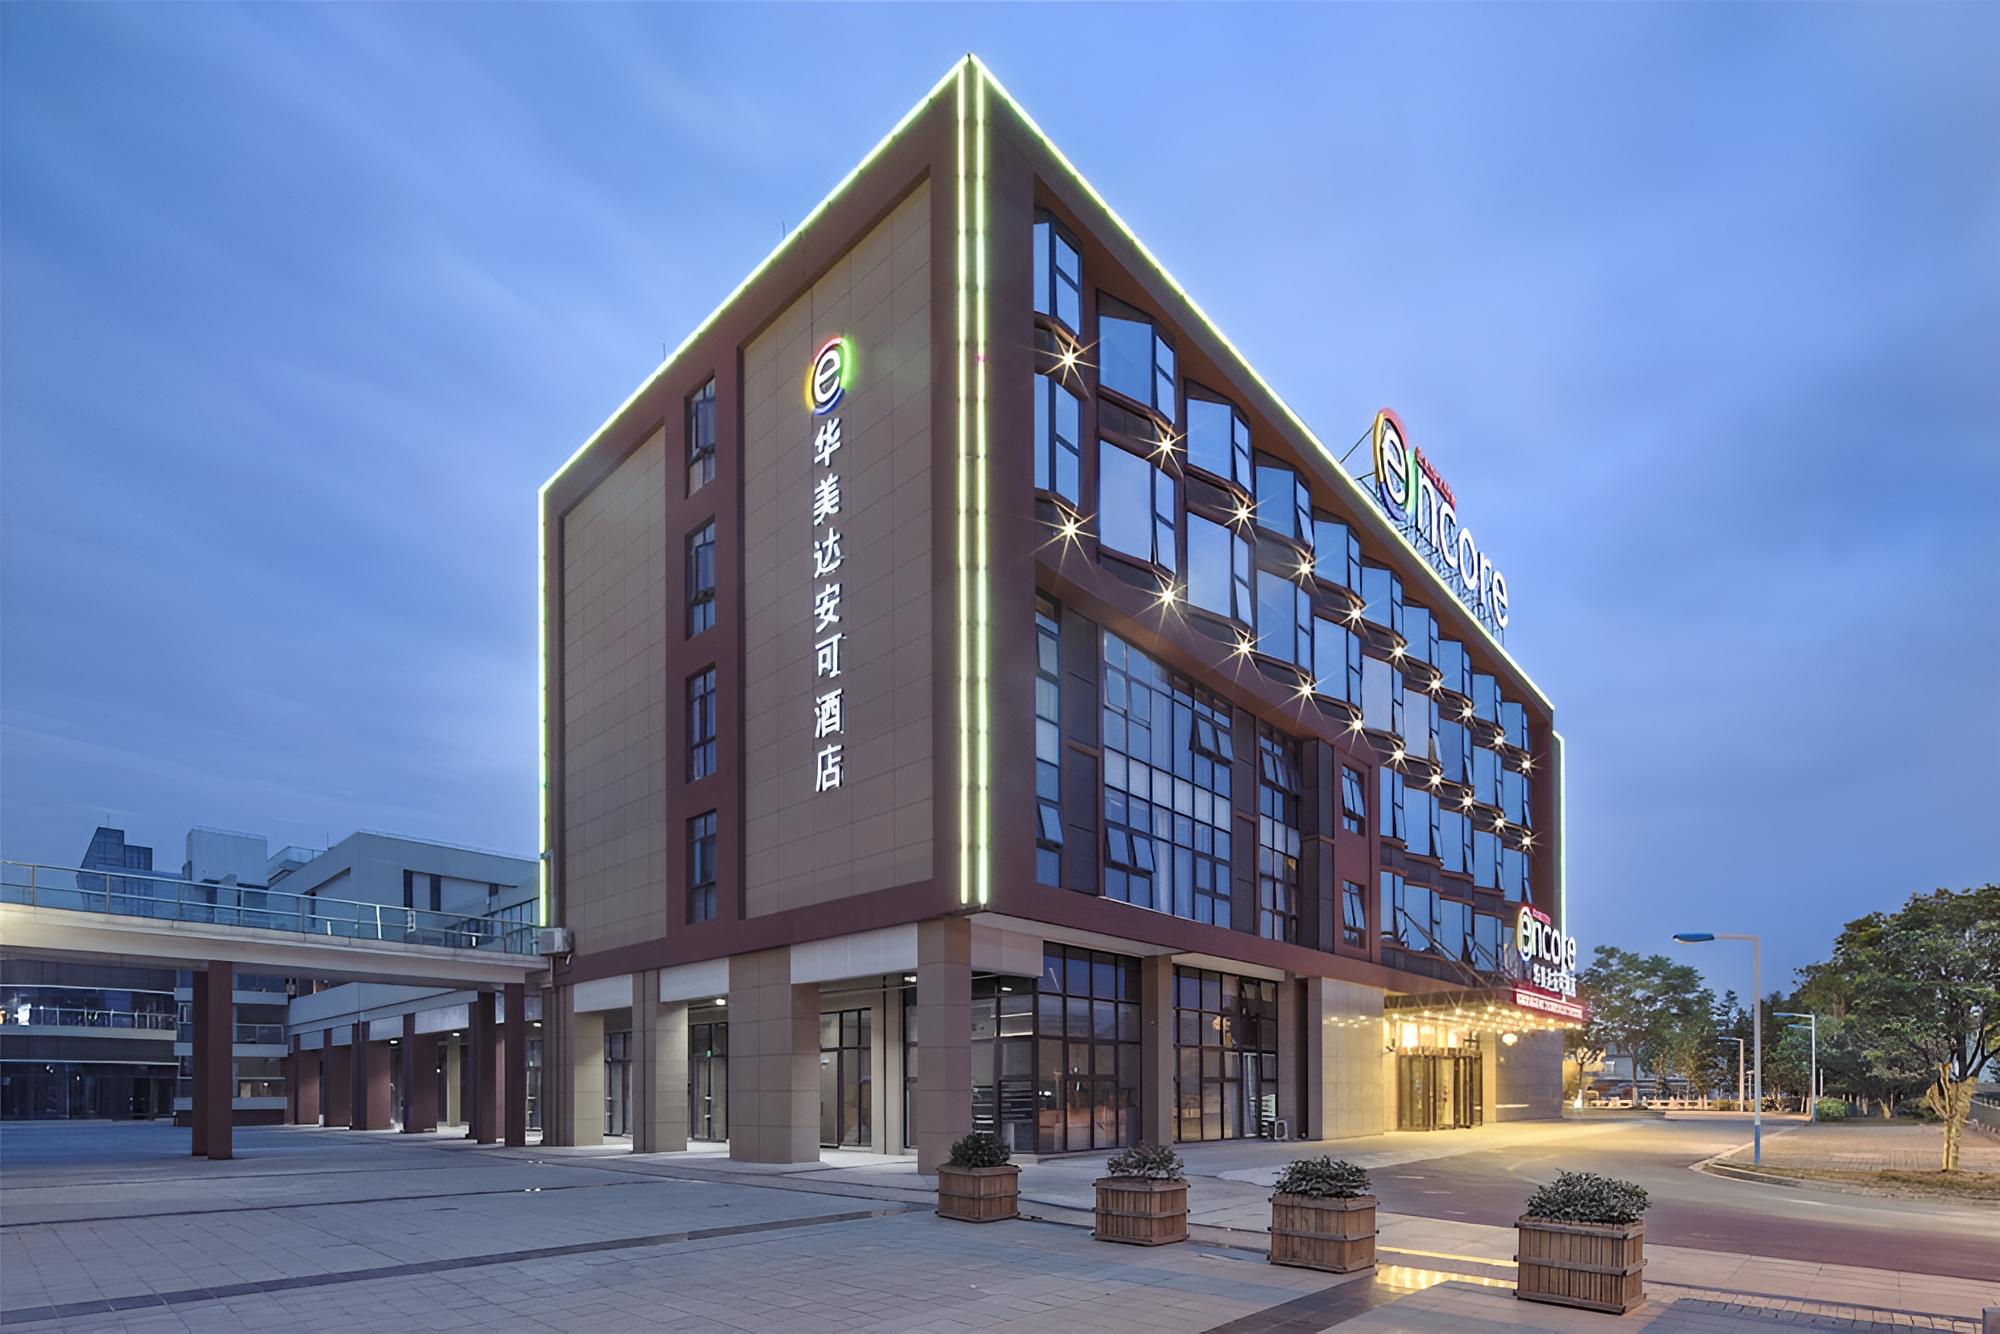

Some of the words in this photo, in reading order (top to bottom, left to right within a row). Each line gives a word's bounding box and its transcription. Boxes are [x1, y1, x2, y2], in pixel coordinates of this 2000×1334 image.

[813, 417, 843, 792] 华美达安可酒店
[1379, 425, 1509, 629] encore
